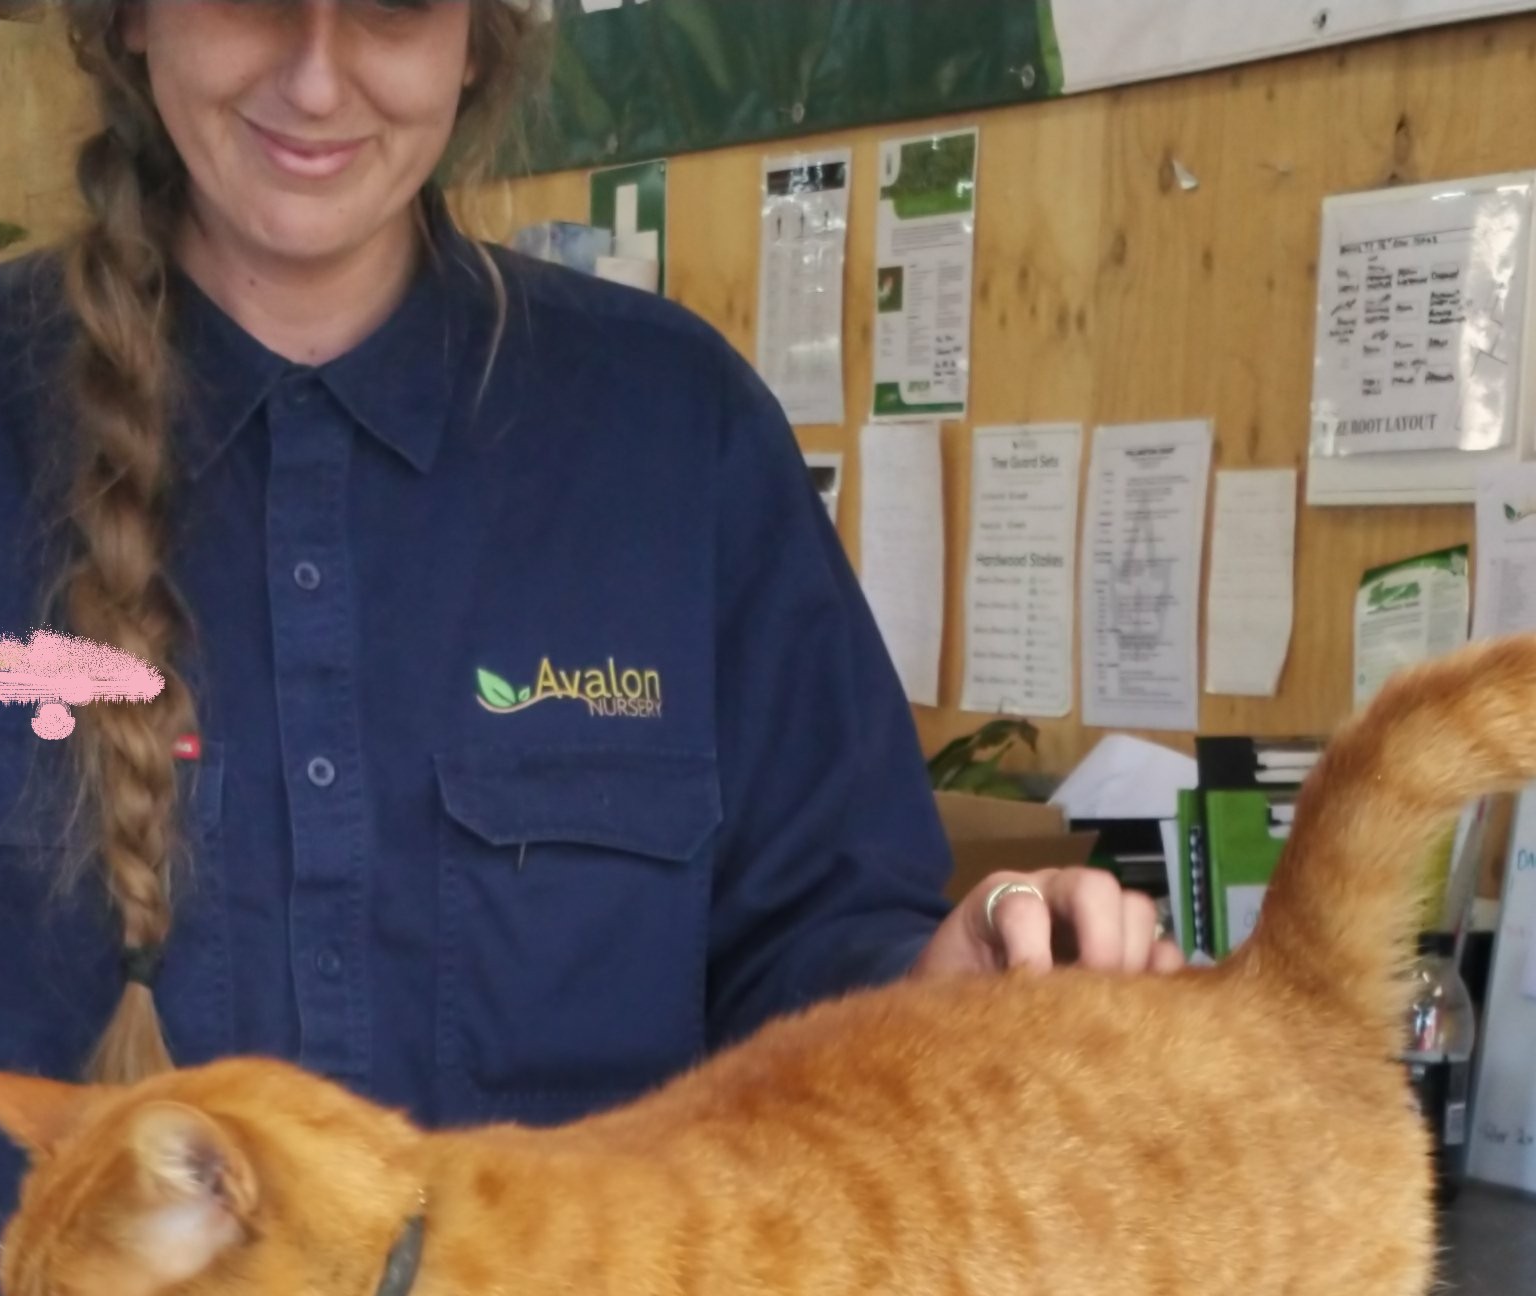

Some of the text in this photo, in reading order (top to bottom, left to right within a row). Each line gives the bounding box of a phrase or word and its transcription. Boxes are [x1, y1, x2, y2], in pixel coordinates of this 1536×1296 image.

[1350, 417, 1383, 434] ROOT
[1384, 413, 1438, 433] LAYOUT
[975, 552, 1064, 569] Hardwood Stakes
[535, 656, 661, 700] Avalon
[588, 698, 663, 718] NURSERY
